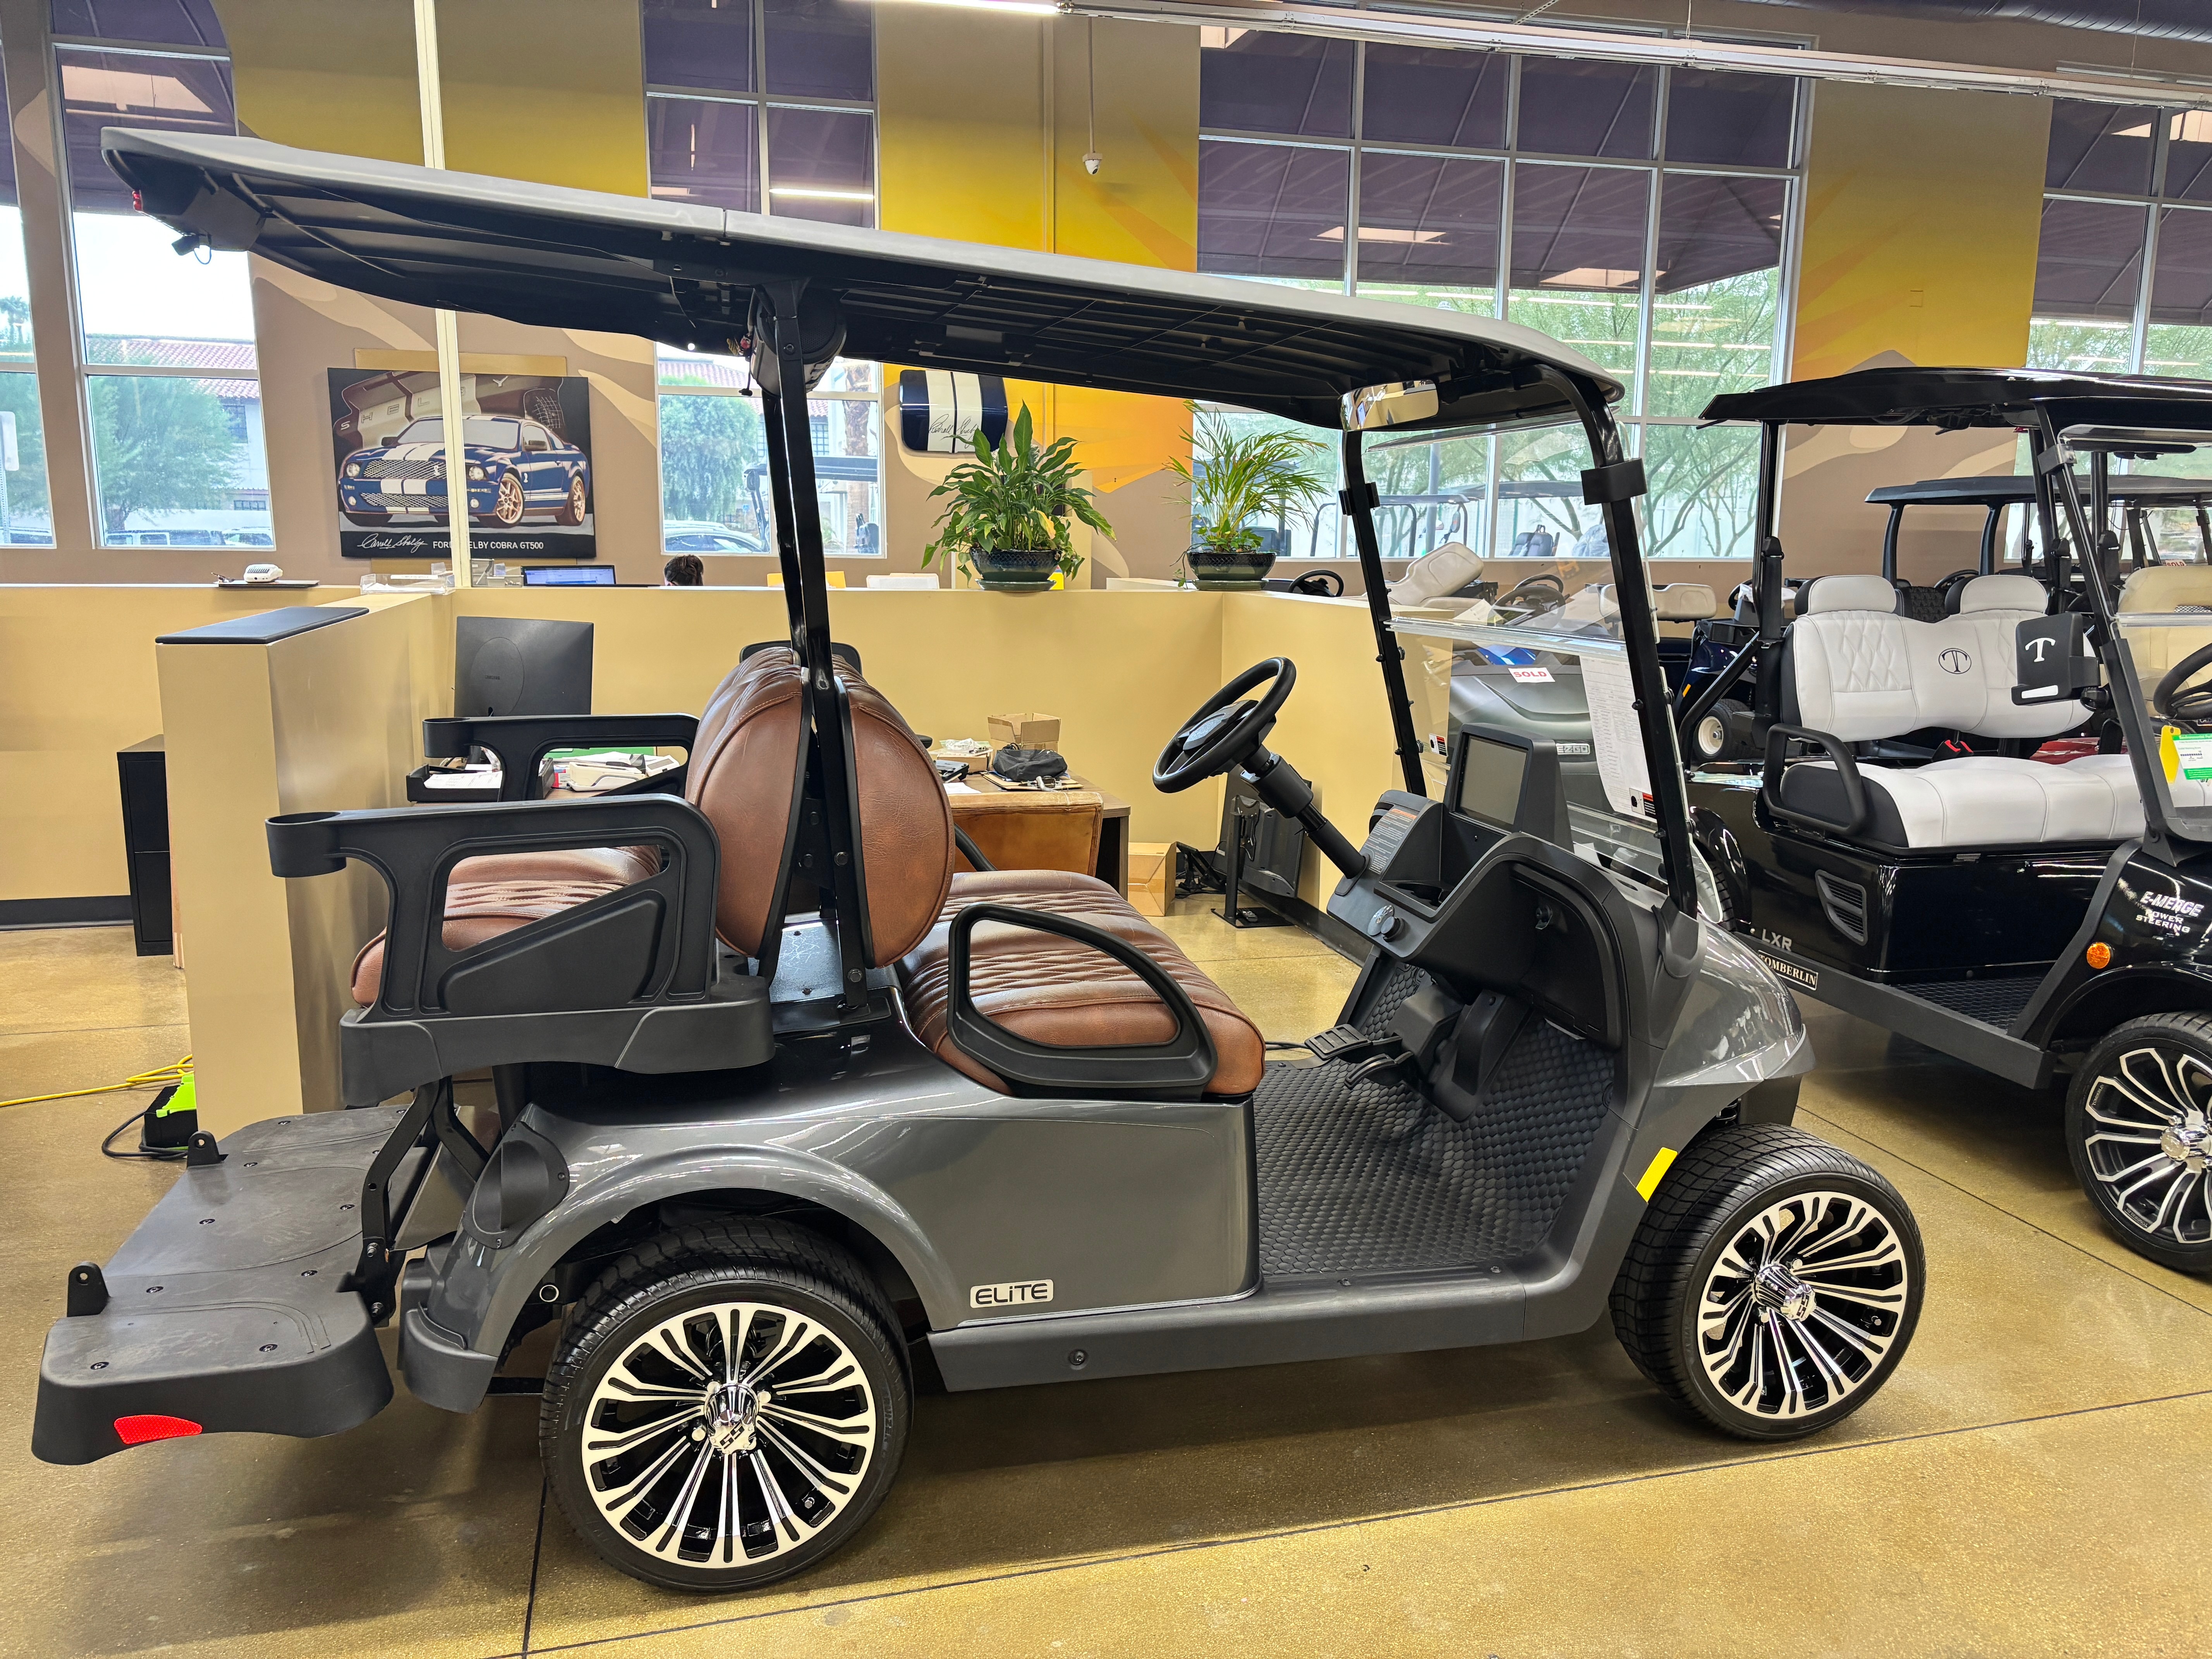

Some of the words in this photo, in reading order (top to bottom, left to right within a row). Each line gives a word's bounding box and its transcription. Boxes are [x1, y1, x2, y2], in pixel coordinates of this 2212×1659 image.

[469, 541, 488, 549] ELBY
[2140, 891, 2204, 917] E-MERGE
[2136, 915, 2191, 933] STEERING
[2145, 910, 2184, 924] POWER
[1762, 929, 1792, 952] LXR
